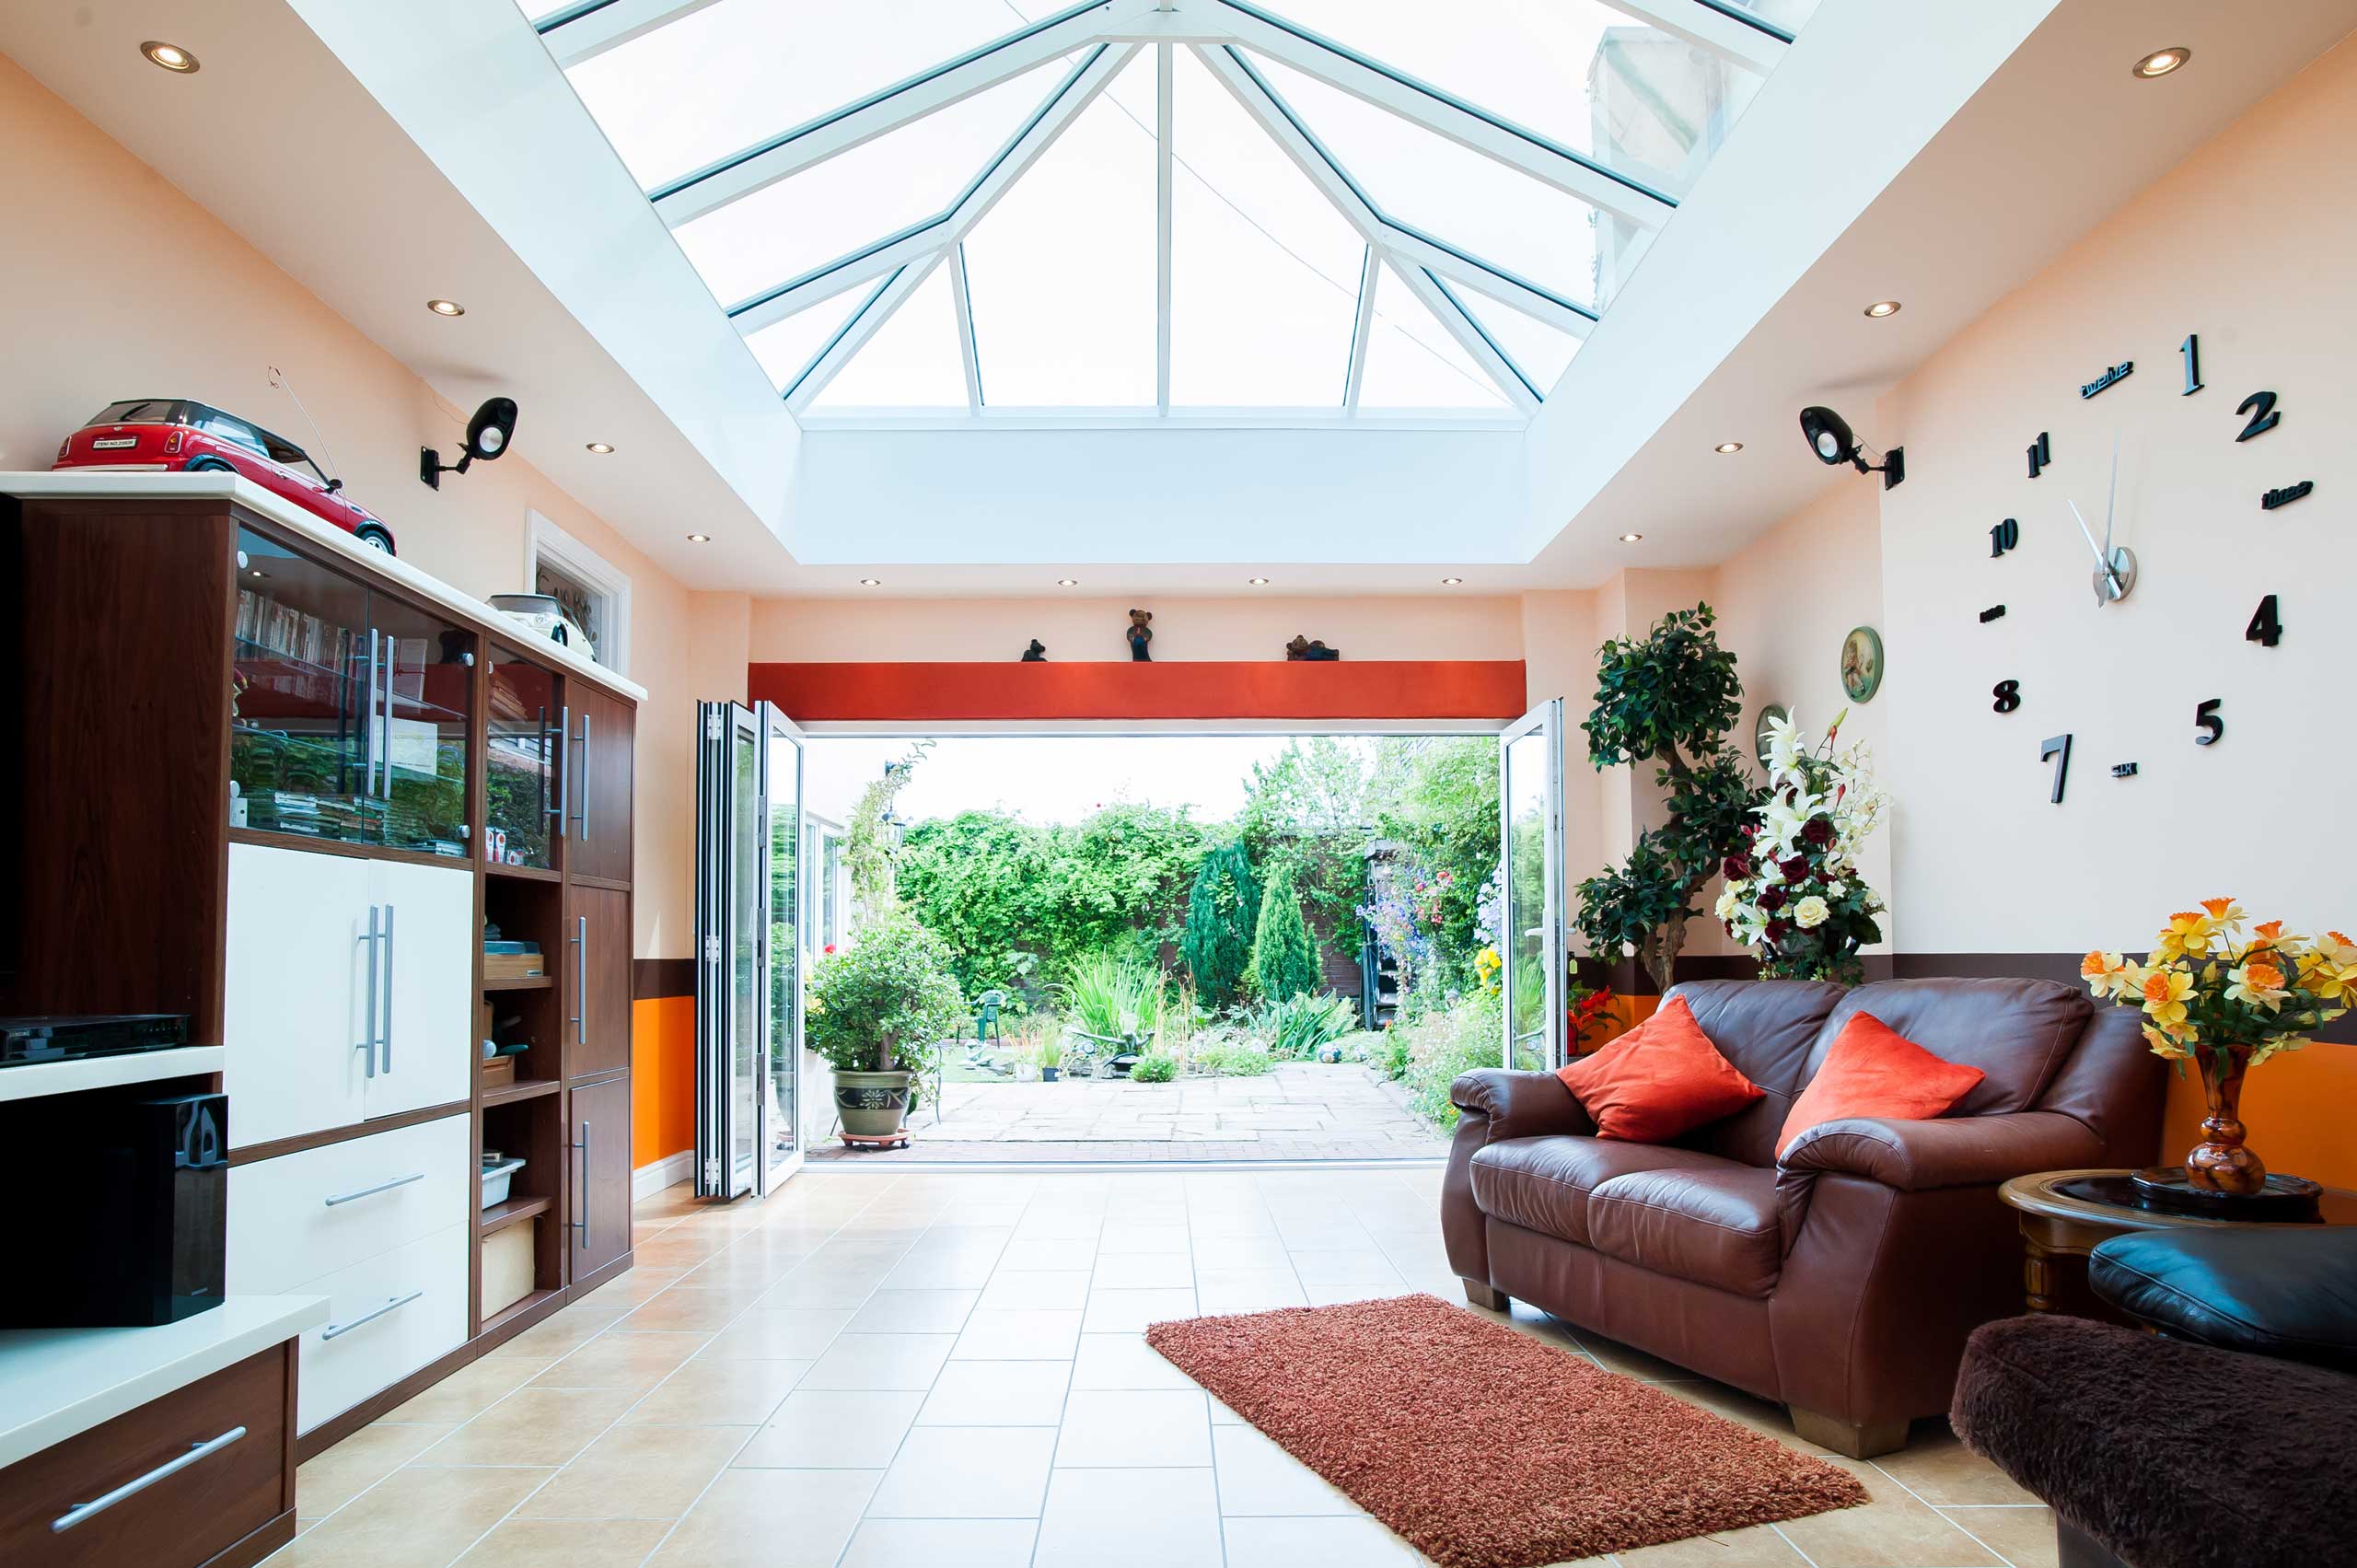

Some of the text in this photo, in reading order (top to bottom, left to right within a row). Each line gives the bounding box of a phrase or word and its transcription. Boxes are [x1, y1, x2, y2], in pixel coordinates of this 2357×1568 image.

[2079, 360, 2134, 400] twelve
[2180, 333, 2206, 397] 1
[2235, 390, 2282, 443] 2
[2026, 432, 2051, 479] 11
[2261, 482, 2315, 511] three
[1989, 517, 2019, 559] 10
[2245, 594, 2283, 648] 4
[1992, 679, 2021, 714] 8
[2195, 698, 2224, 747] 5
[2040, 734, 2073, 805] 7
